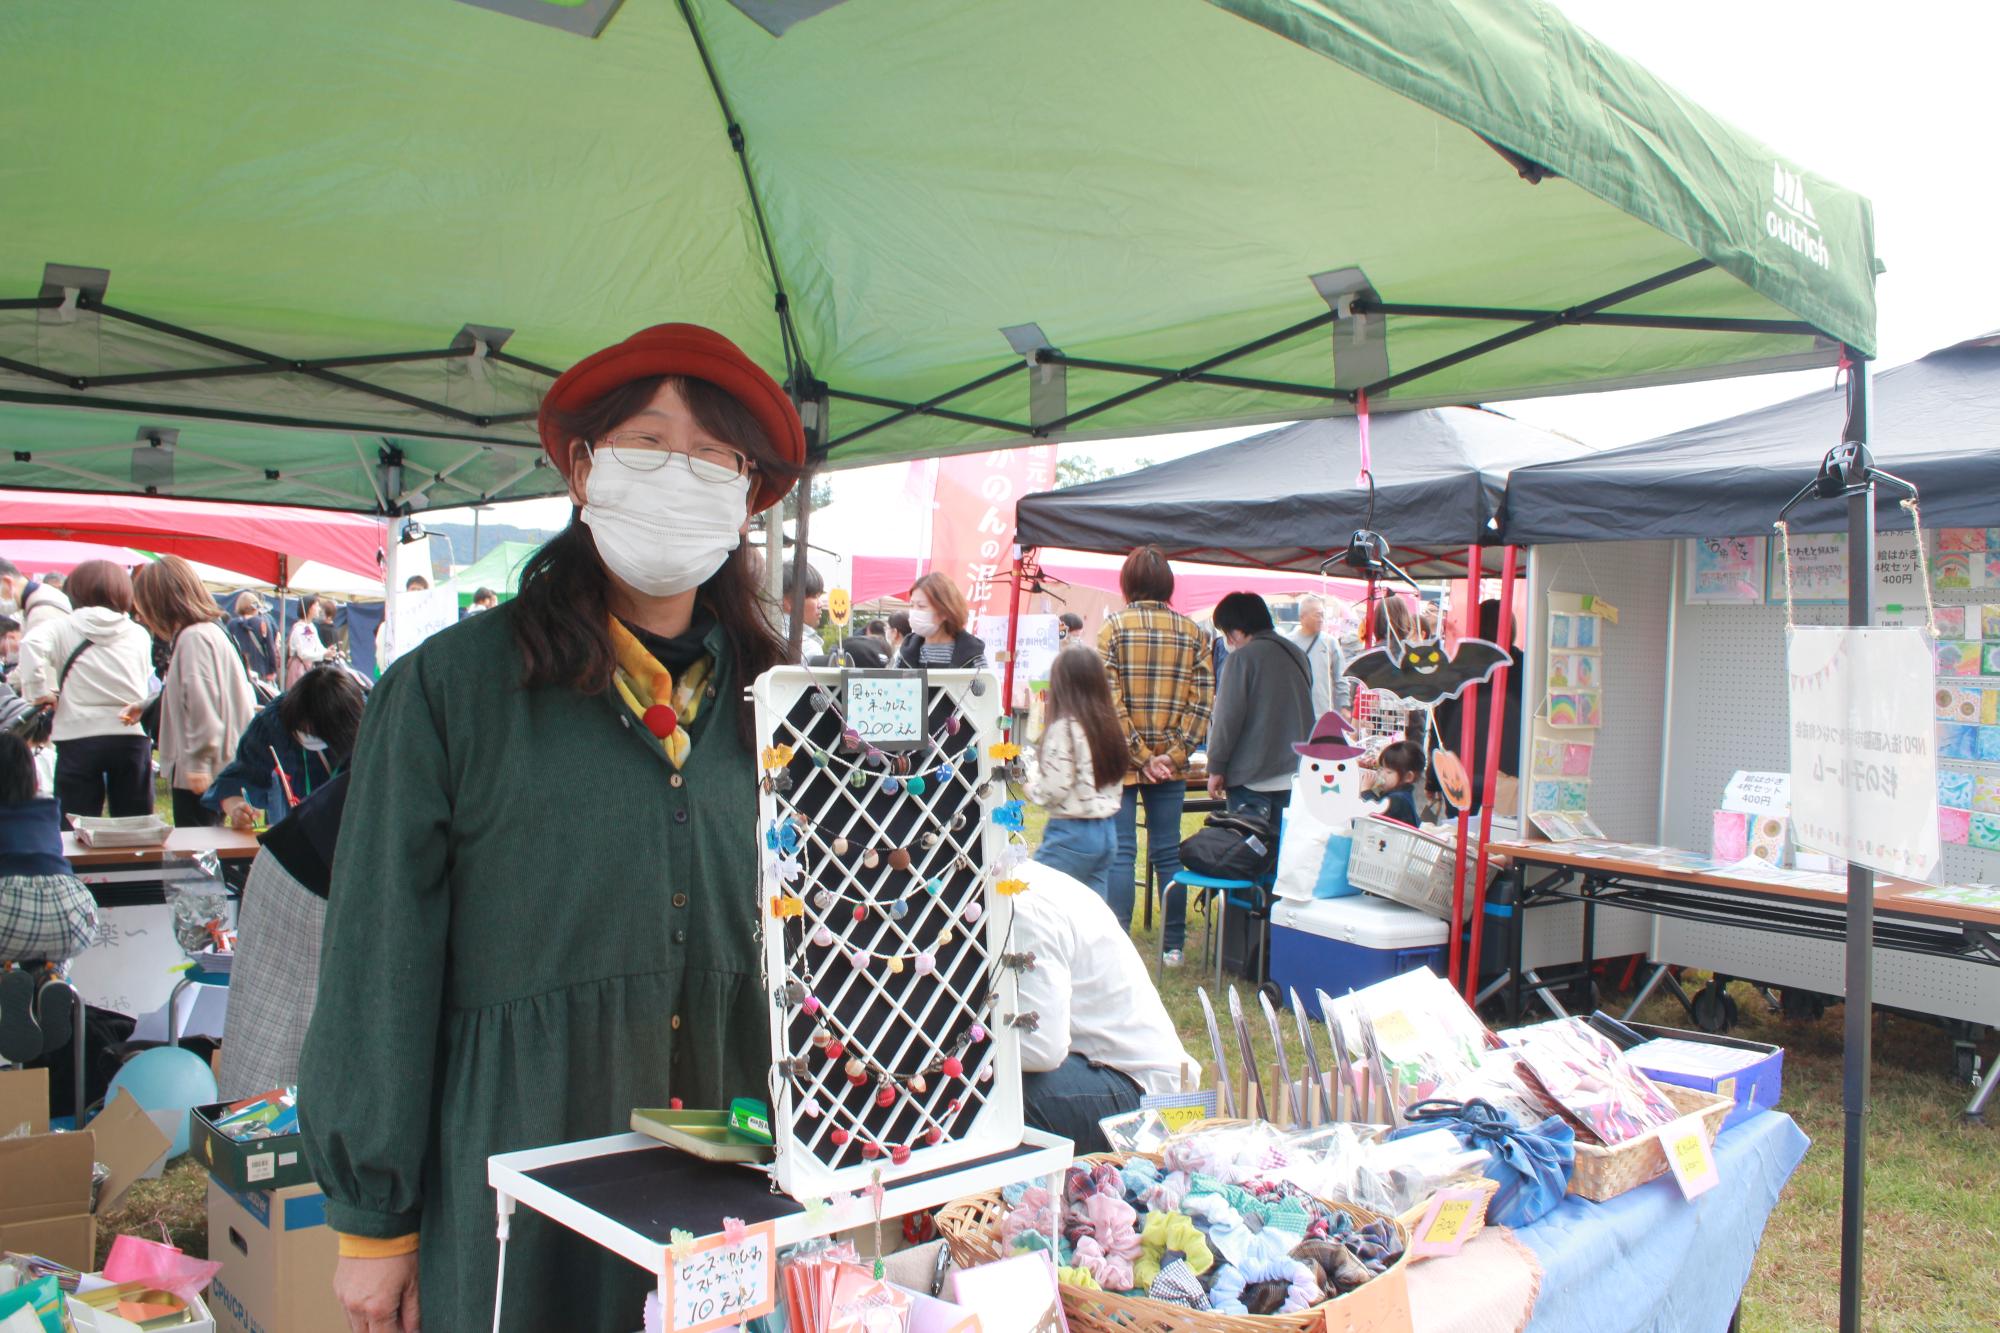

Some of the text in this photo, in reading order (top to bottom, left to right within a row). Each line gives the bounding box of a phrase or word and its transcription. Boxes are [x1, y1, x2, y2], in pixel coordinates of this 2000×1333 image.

[1765, 211, 1829, 270] outrich
[1877, 550, 1918, 561] 絵はがき
[1874, 561, 1921, 573] 4枚セット
[1882, 574, 1912, 584] 400円
[868, 699, 906, 712] ネックレス
[1737, 784, 1782, 795] 4枚セット
[1742, 794, 1771, 807] 400円
